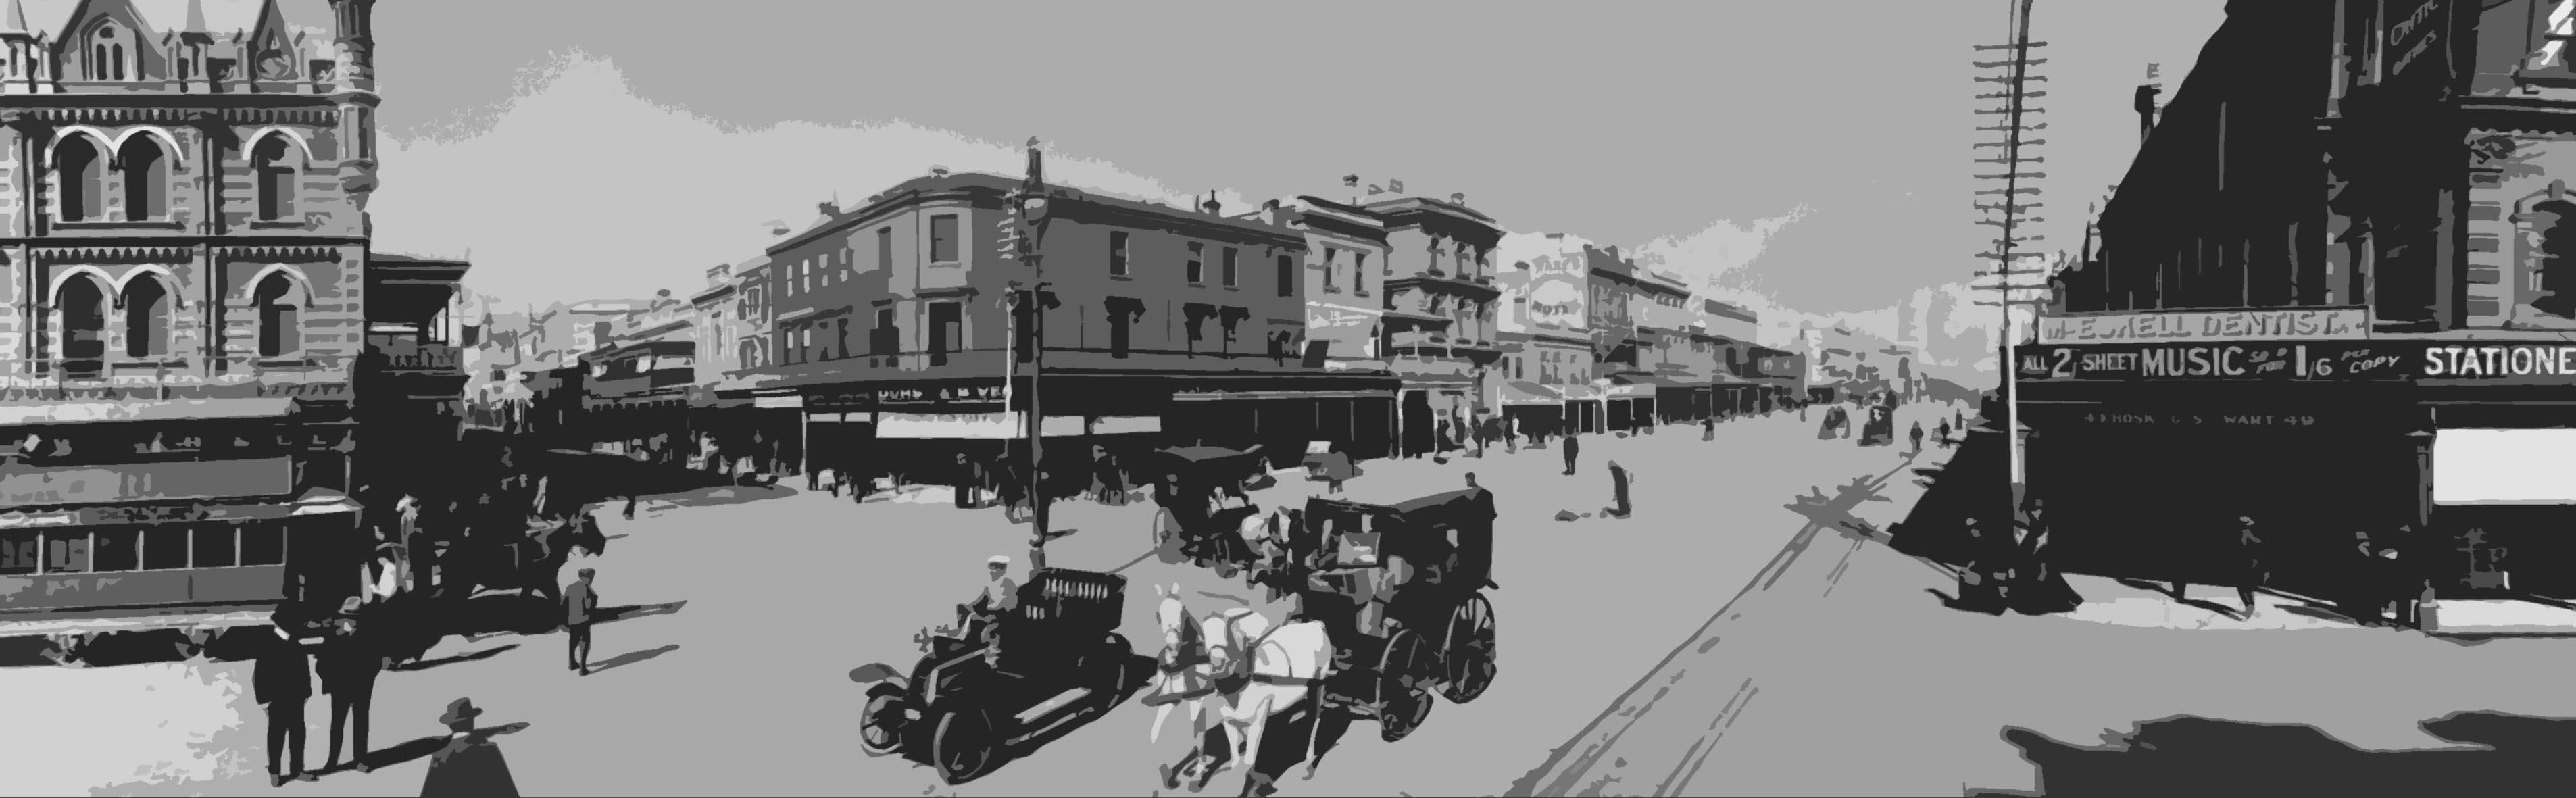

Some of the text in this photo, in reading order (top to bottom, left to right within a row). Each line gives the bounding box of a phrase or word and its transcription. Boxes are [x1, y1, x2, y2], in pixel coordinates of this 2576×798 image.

[2202, 311, 2339, 336] DENTIST
[2022, 356, 2048, 372] ALL
[2081, 353, 2139, 371] SHEET
[2141, 345, 2246, 376] MUSIC
[2349, 355, 2402, 373] COPY
[2424, 347, 2576, 376] STATIONE
